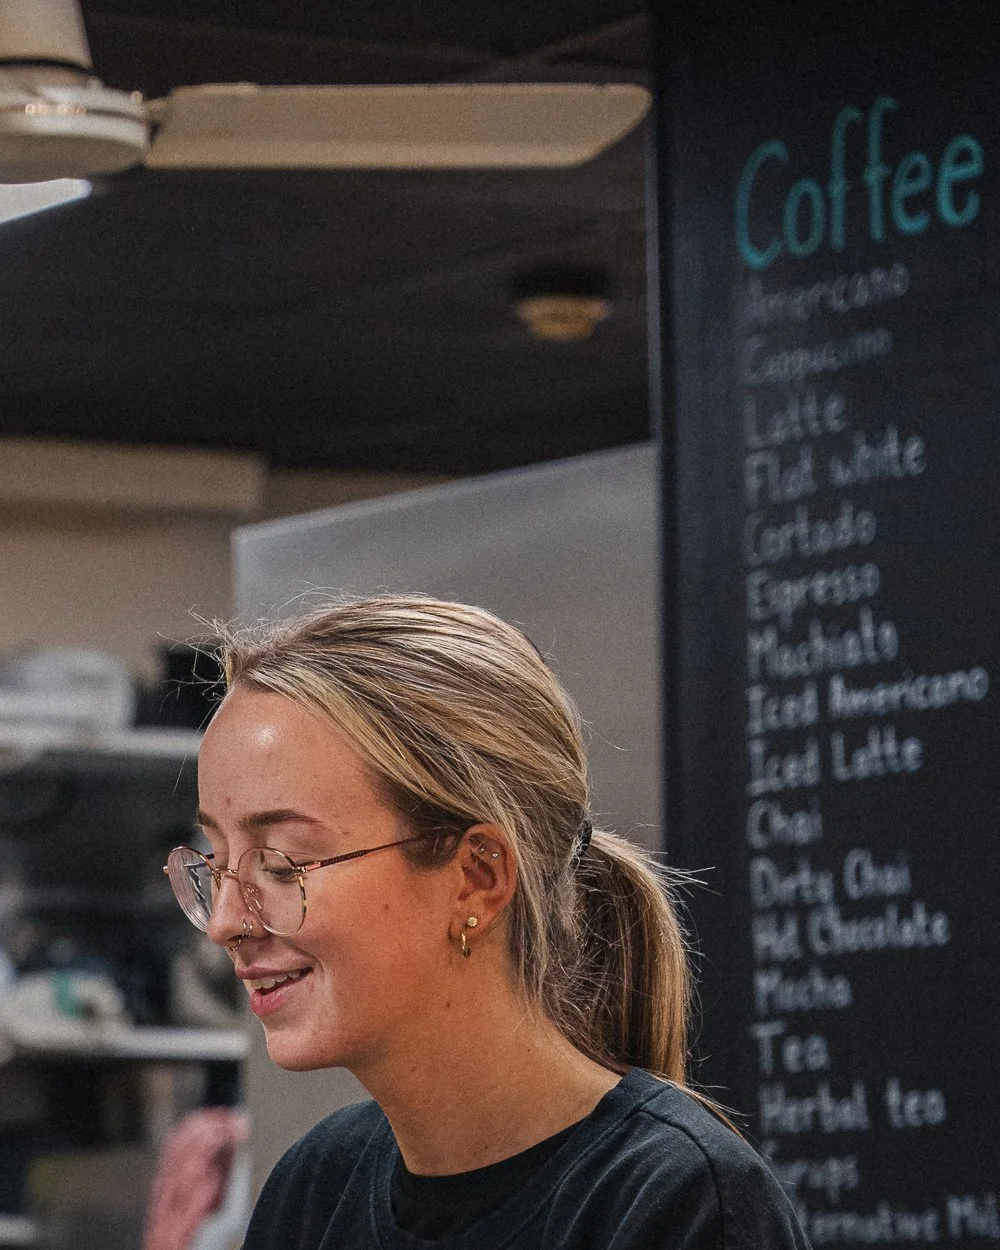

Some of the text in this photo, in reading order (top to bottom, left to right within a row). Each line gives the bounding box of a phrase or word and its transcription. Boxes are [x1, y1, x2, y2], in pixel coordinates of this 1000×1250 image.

[736, 95, 984, 269] Coffee
[744, 391, 845, 449] Latte
[745, 426, 926, 507] Flat white
[744, 501, 876, 565] Cortado
[746, 564, 880, 627] Espresso
[746, 667, 989, 735] Iced Americano
[746, 726, 922, 796] Iced Latte
[746, 798, 823, 848] Chai
[750, 849, 911, 908] Dirty Chai
[752, 901, 950, 961] Hot Chocolate
[754, 968, 852, 1015] Mocha
[750, 1020, 829, 1075] Tea
[759, 1077, 946, 1132] Herbal tea
[946, 1194, 1000, 1239] Mil
